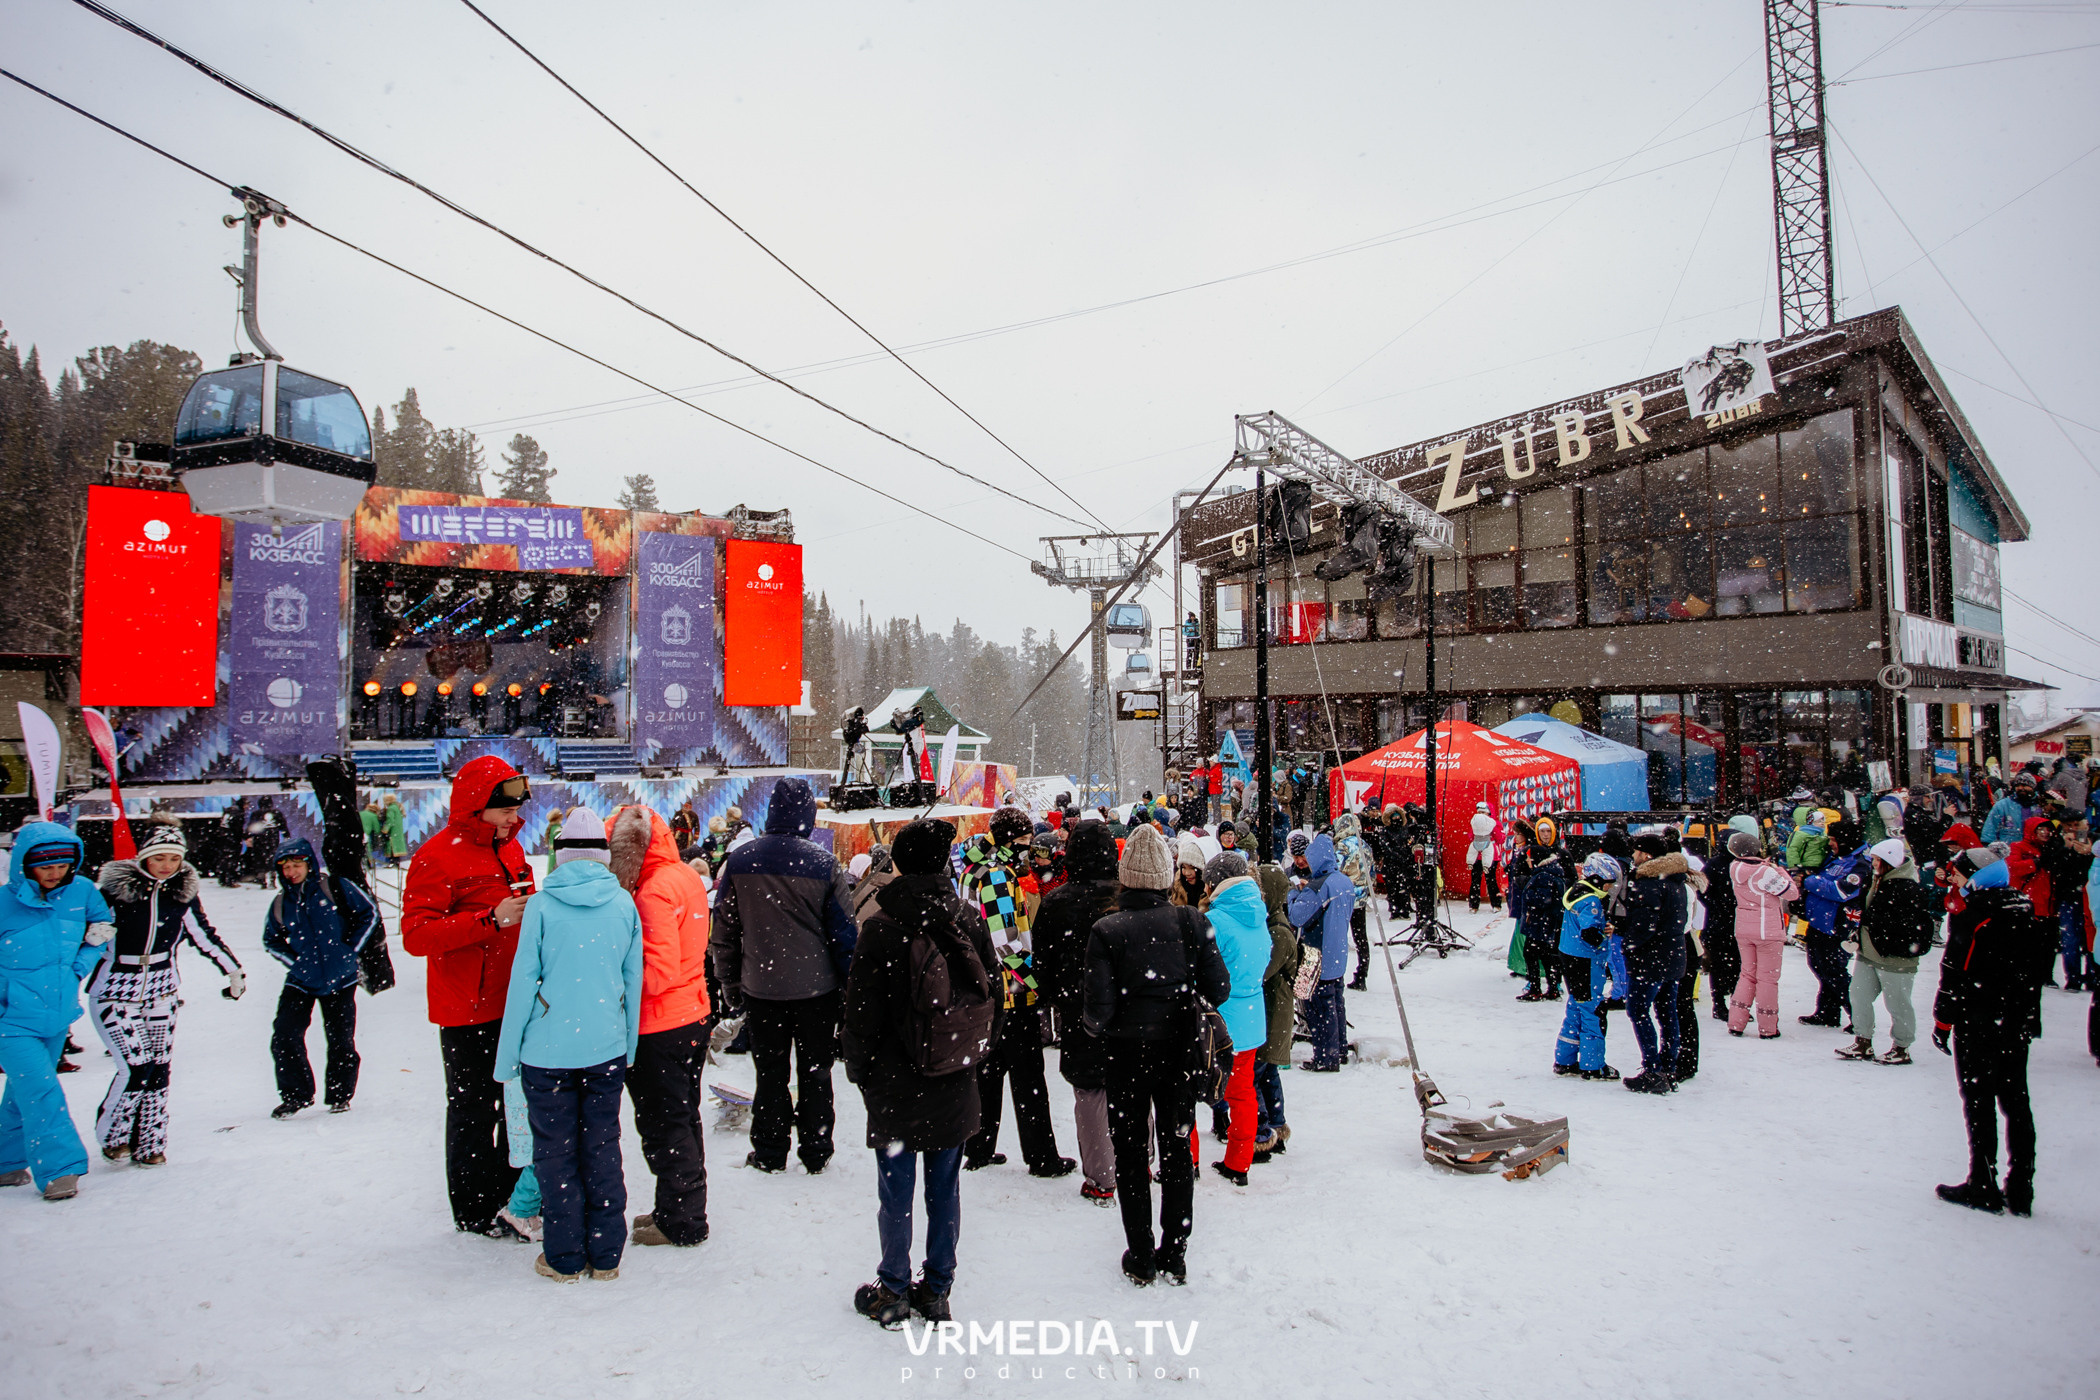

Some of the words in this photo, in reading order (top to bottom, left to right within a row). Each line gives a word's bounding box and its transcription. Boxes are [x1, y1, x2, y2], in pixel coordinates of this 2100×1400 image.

[1704, 399, 1763, 429] ZUBR
[1425, 390, 1650, 514] ZUBR
[411, 513, 574, 543] ШЕРЕГЕШ
[249, 547, 326, 565] КУЗБАСС
[523, 545, 588, 567] ФЕСТ
[649, 562, 674, 575] 300
[649, 574, 703, 589] КУЗБАСС
[1092, 602, 1103, 611] 10
[1906, 616, 1958, 669] ПРОКАТ
[1371, 759, 1413, 769] МЕДИА
[1414, 761, 1460, 770] ГРППА
[1383, 751, 1461, 760] КУЗБАСКАЯ
